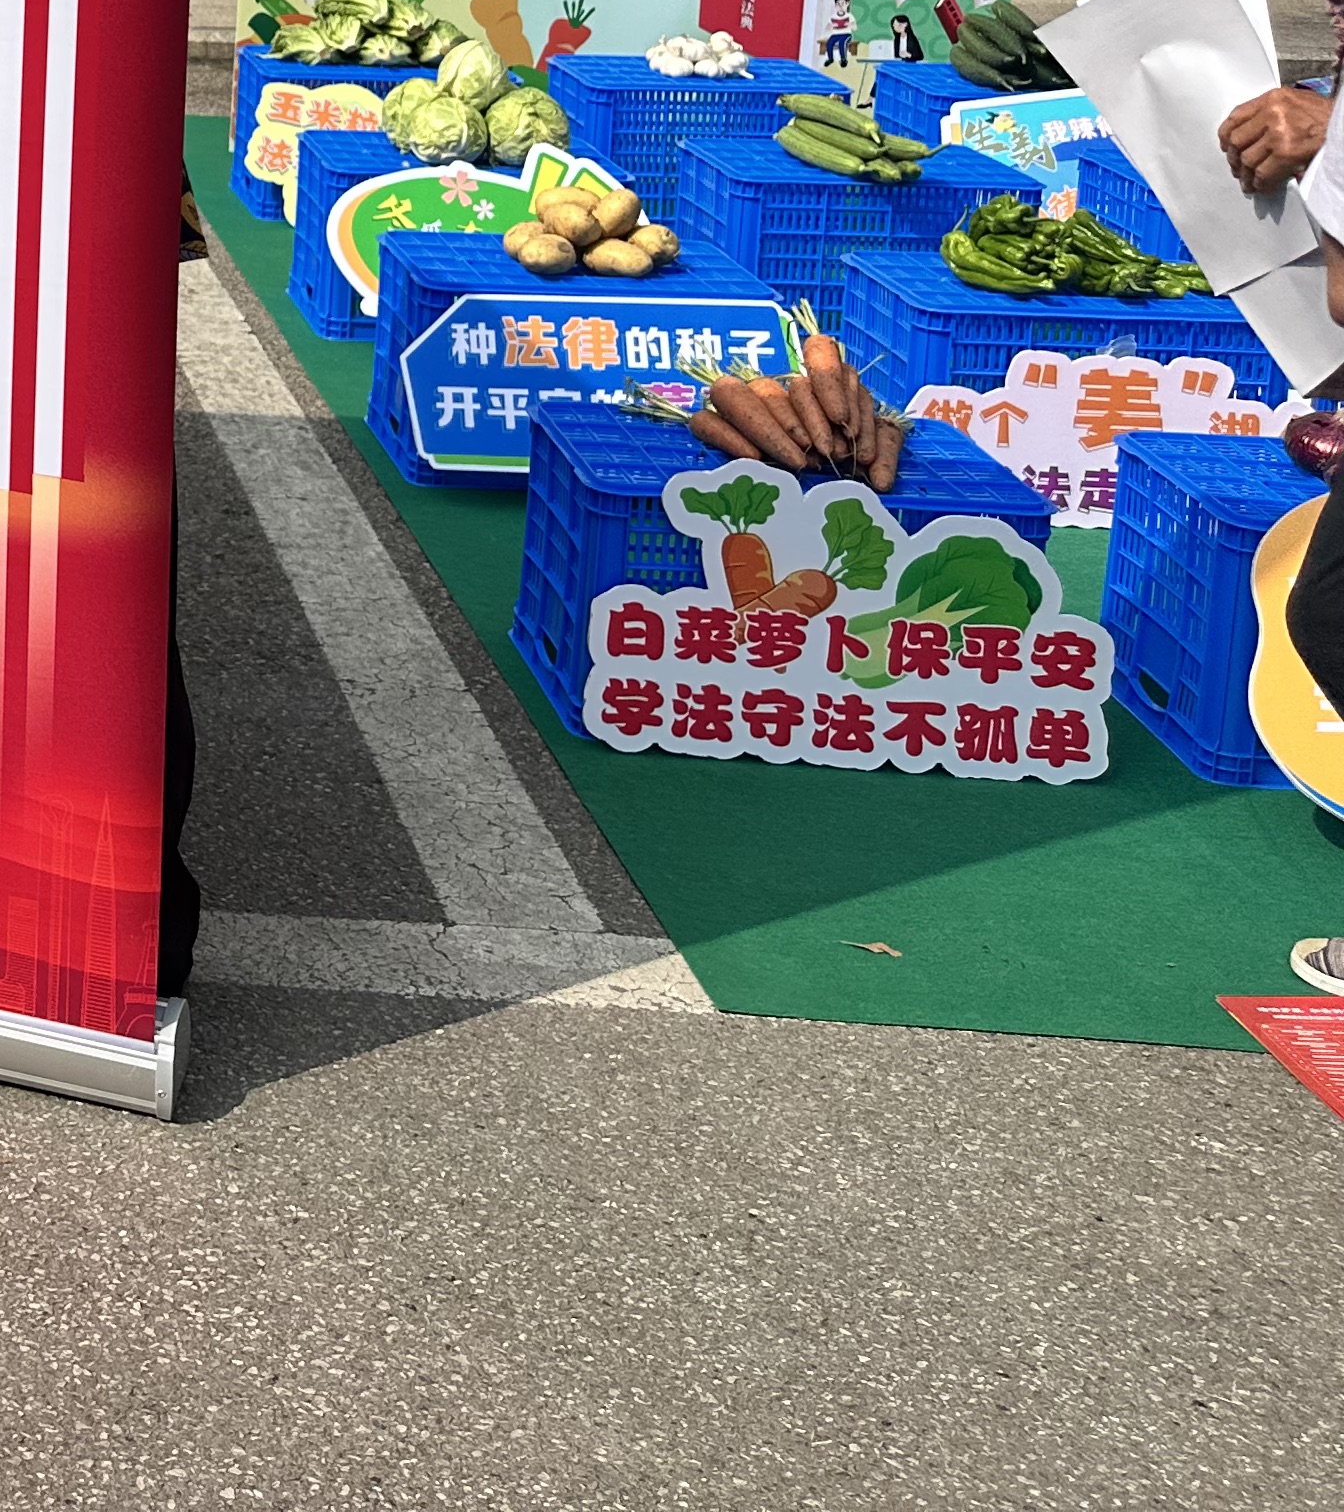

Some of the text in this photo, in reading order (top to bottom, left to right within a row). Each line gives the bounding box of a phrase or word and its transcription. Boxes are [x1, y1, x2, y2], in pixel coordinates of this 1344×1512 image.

[451, 316, 776, 371] 种法律的种子
[605, 601, 1098, 691] 白菜萝卜保平安
[600, 677, 1092, 768] 学法守法不孤单
